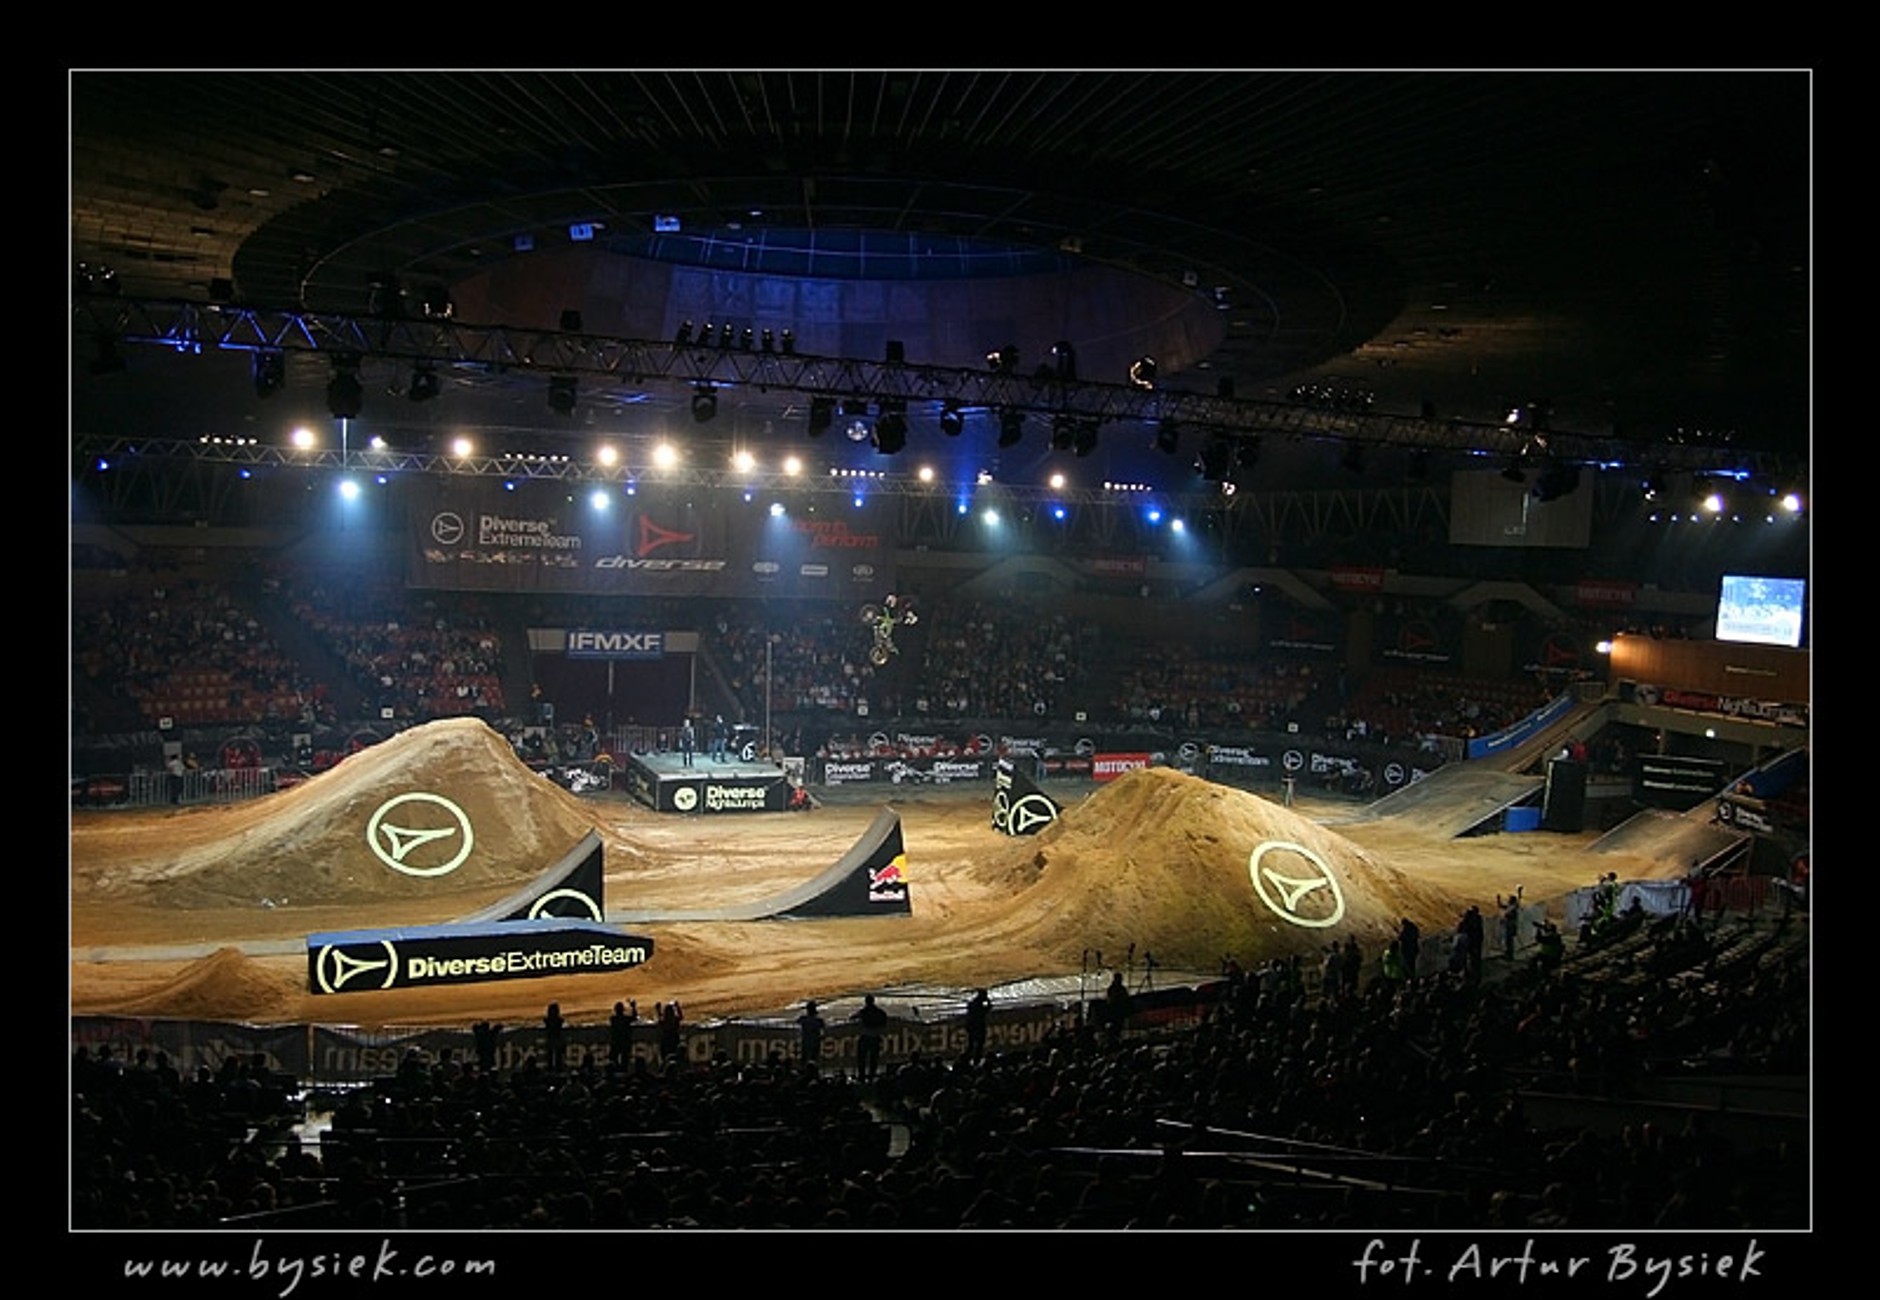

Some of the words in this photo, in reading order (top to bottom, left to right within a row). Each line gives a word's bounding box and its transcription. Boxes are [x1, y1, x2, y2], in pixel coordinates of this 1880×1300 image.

[479, 514, 549, 534] Diverse
[595, 555, 725, 570] diverse
[569, 632, 661, 650] IFMXF
[707, 785, 765, 798] Diverse
